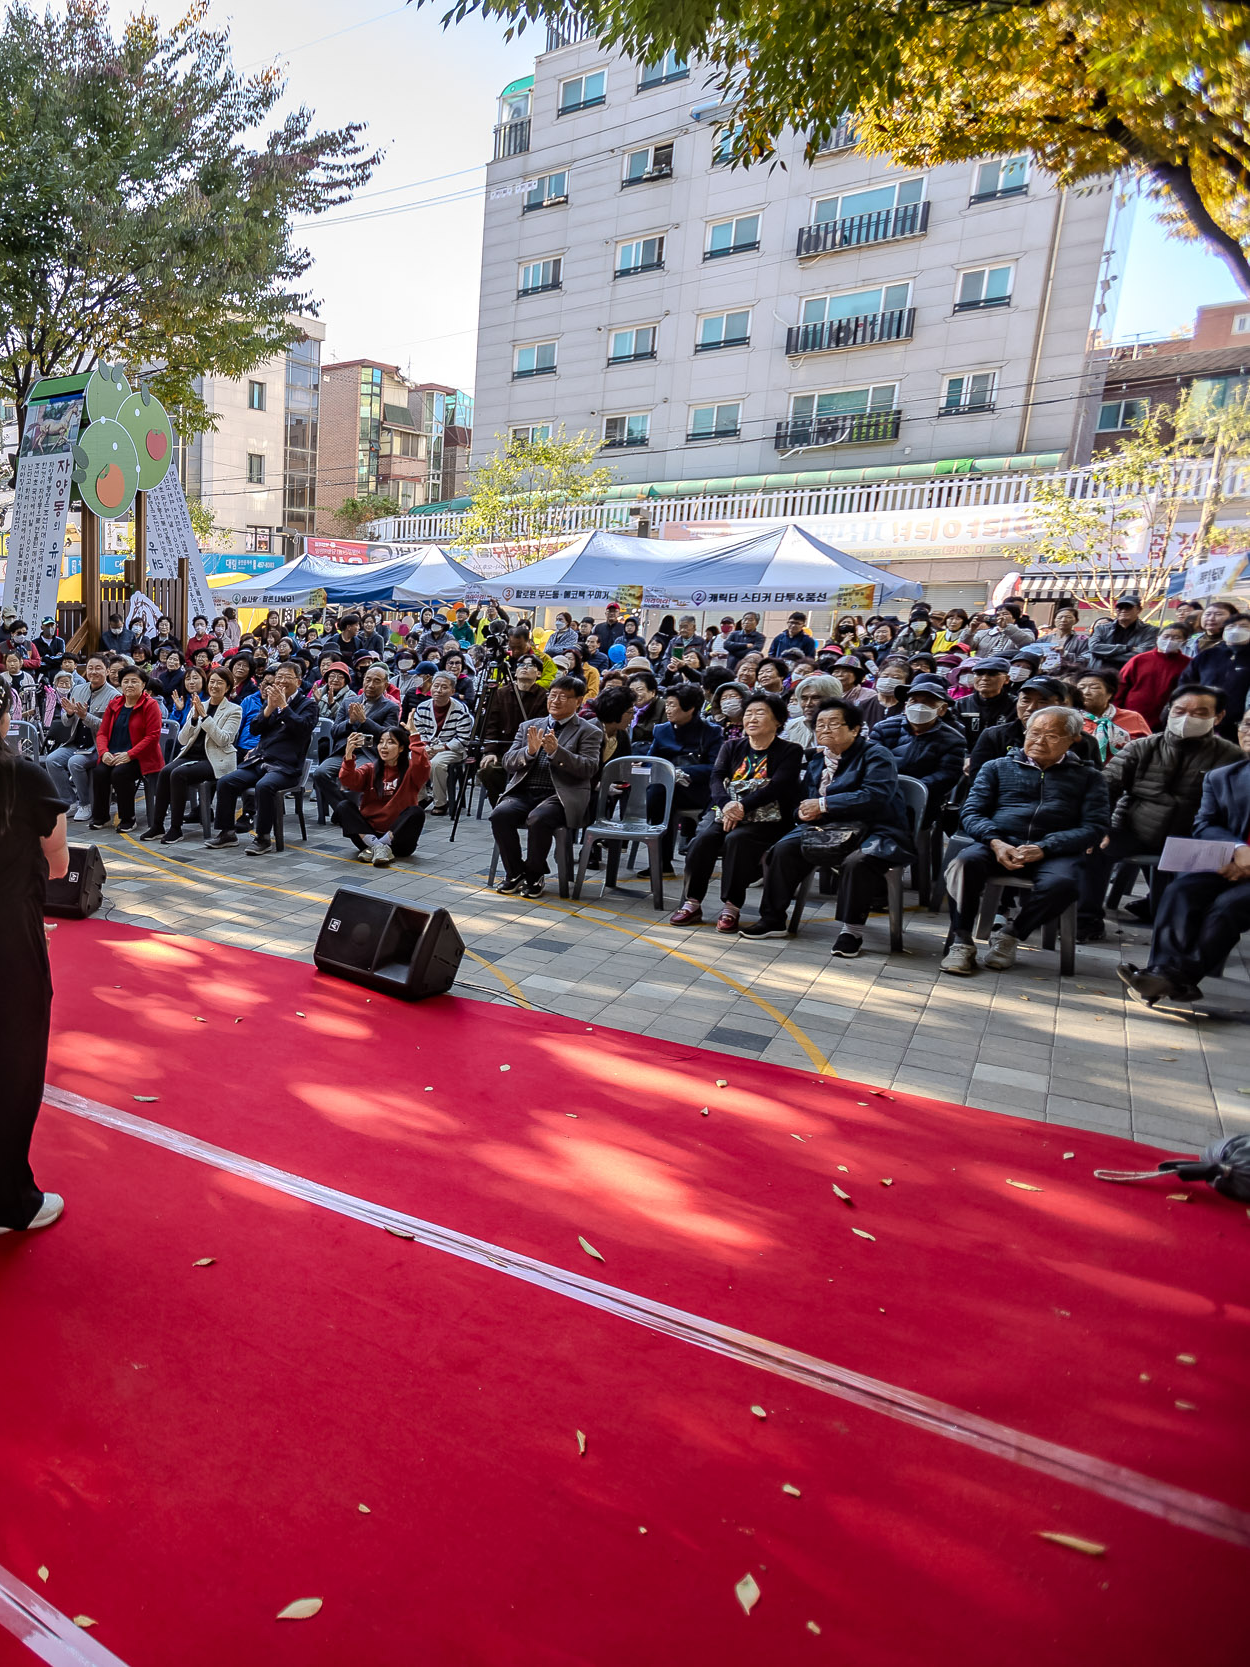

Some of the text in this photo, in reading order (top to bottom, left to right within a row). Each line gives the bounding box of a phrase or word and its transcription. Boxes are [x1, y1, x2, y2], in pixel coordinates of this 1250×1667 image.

[46, 542, 59, 579] 유래
[708, 592, 738, 603] 캐릭터
[740, 592, 772, 603] 스티커
[774, 591, 827, 603] 타투&풍선
